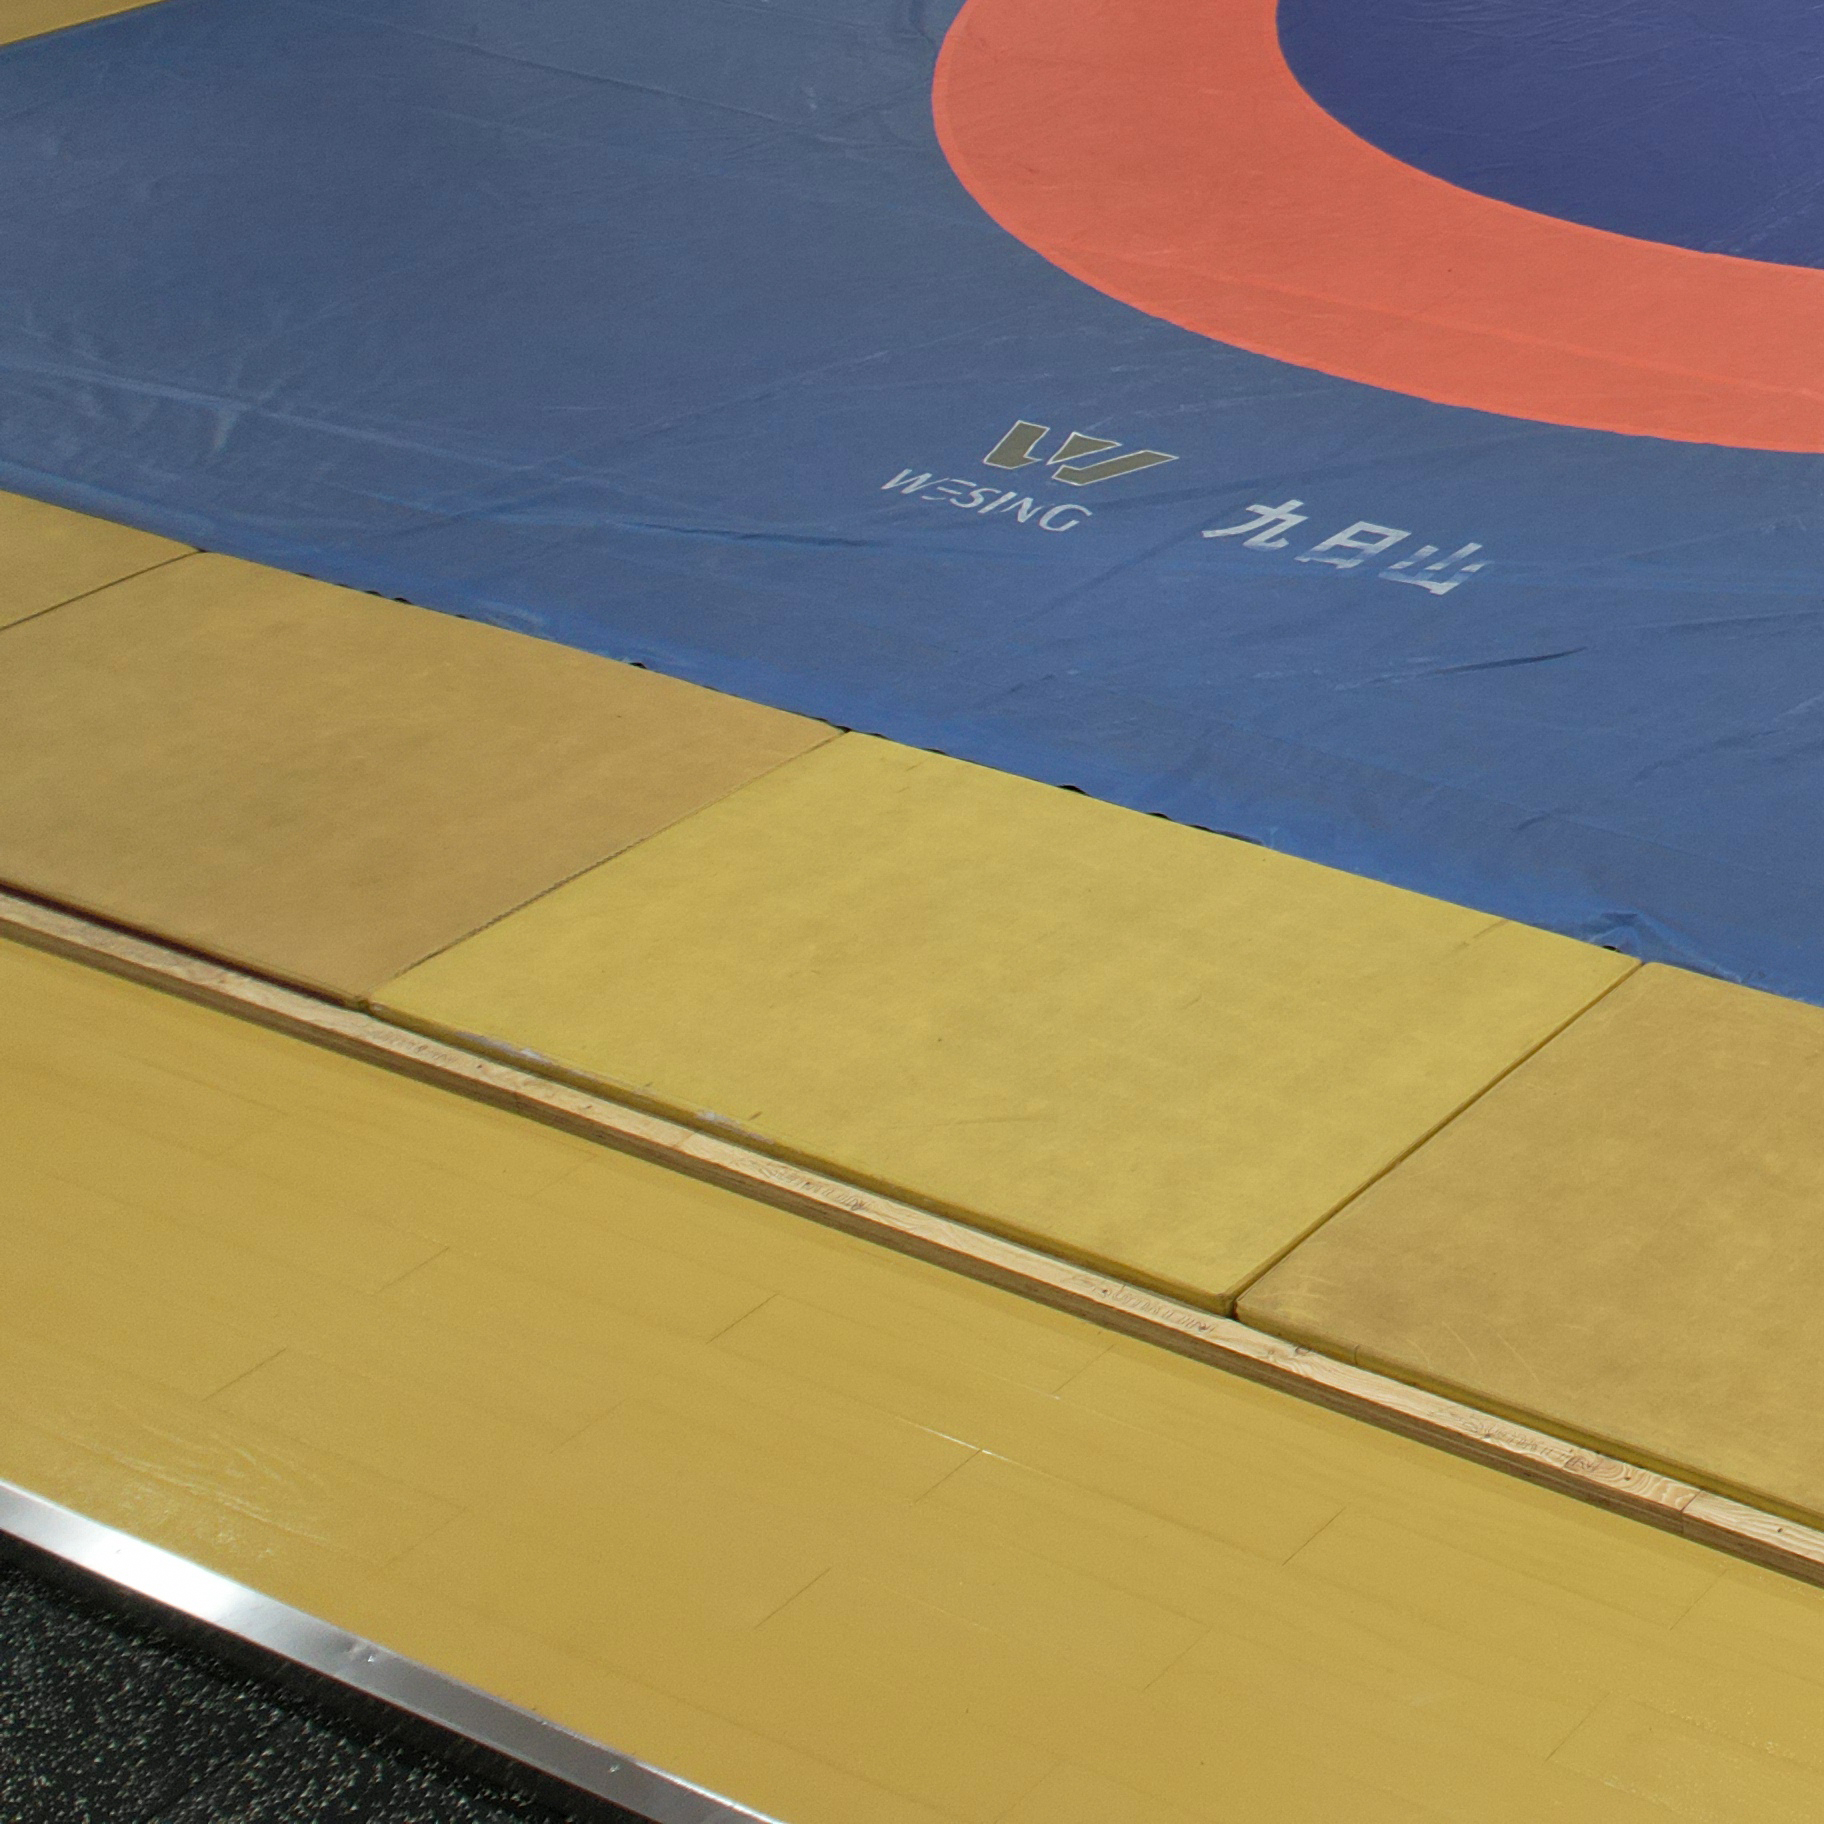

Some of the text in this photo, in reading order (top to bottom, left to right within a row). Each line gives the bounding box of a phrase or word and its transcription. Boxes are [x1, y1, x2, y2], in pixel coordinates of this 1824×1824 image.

[881, 468, 1093, 532] WESING
[1202, 498, 1494, 595] 九日山
